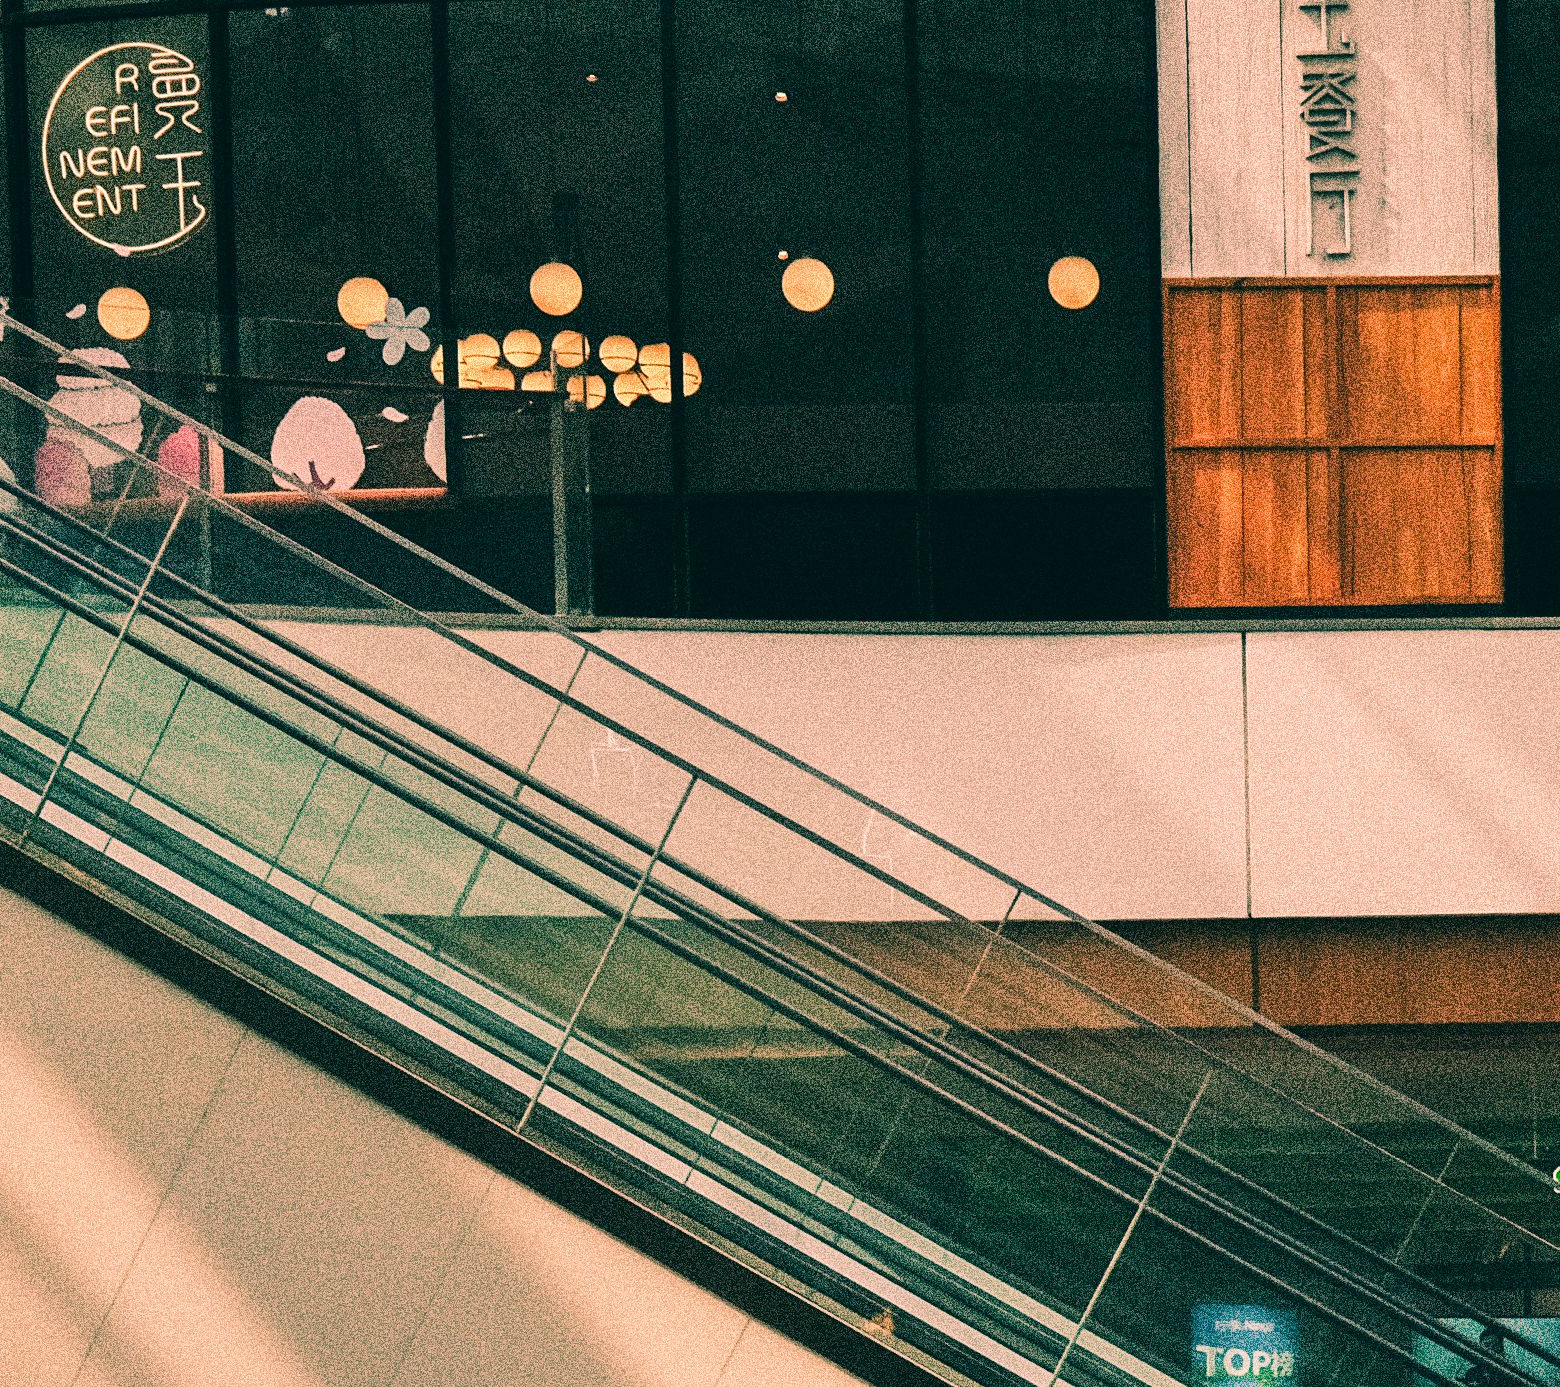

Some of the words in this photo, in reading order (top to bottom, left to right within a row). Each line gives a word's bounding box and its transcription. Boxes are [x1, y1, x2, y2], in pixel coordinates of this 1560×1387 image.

[115, 63, 139, 94] R
[85, 102, 139, 137] EFI
[59, 145, 142, 179] NEM
[73, 184, 146, 219] ENT
